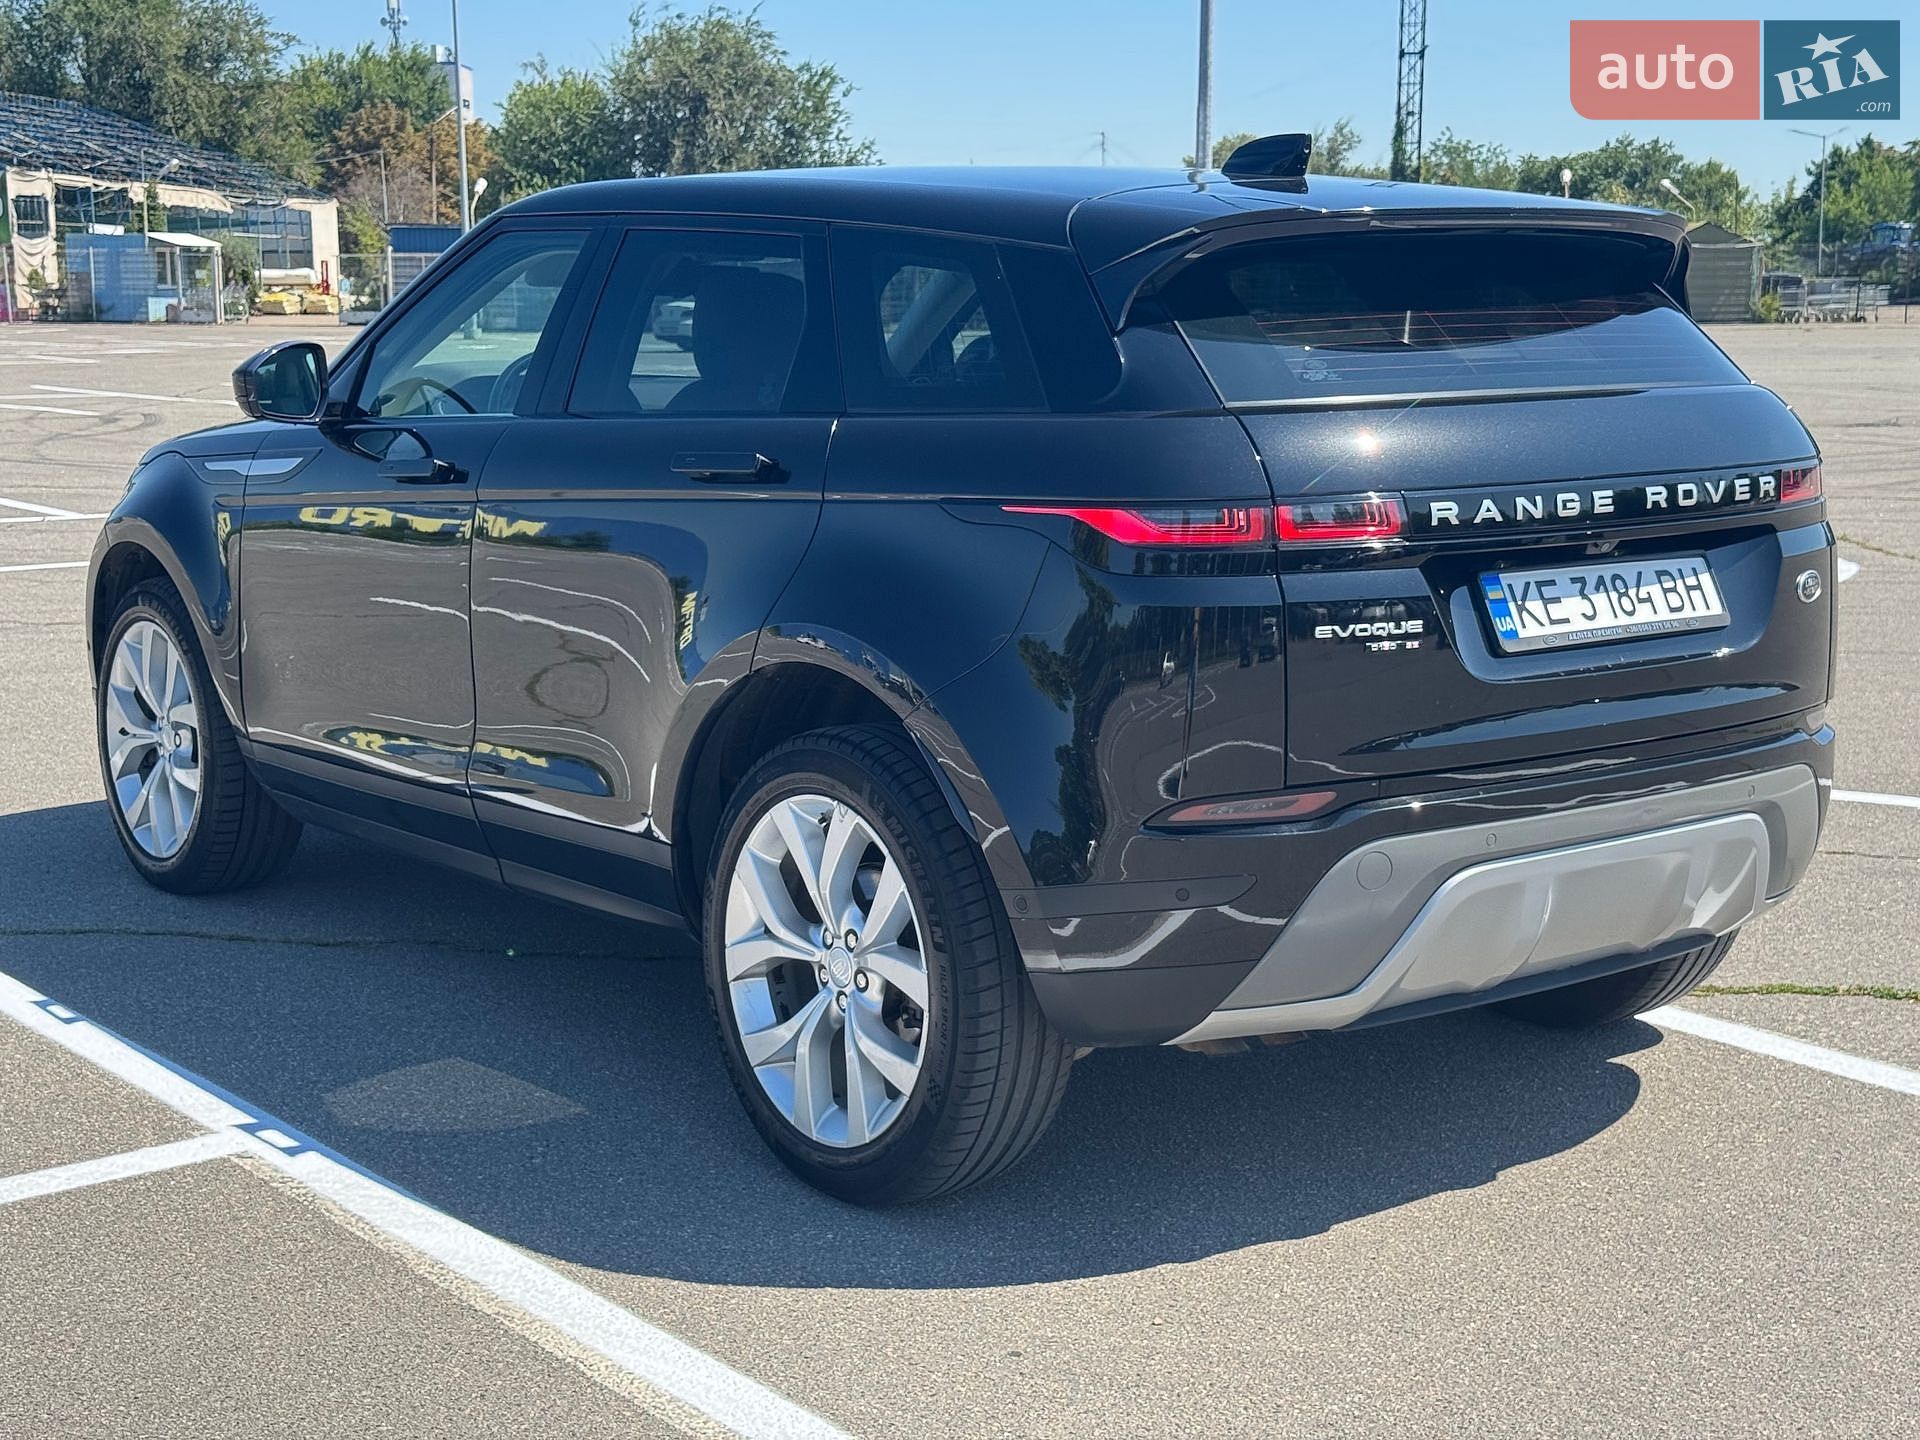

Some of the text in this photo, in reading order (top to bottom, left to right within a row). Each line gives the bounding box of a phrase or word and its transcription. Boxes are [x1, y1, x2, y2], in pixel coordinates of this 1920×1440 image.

[1430, 475, 1776, 526] RANGE ROVER
[1495, 616, 1515, 632] UA
[1506, 567, 1711, 630] KE 3184 BH
[1314, 620, 1424, 639] EVOQUE
[885, 815, 945, 944] MICHELIN
